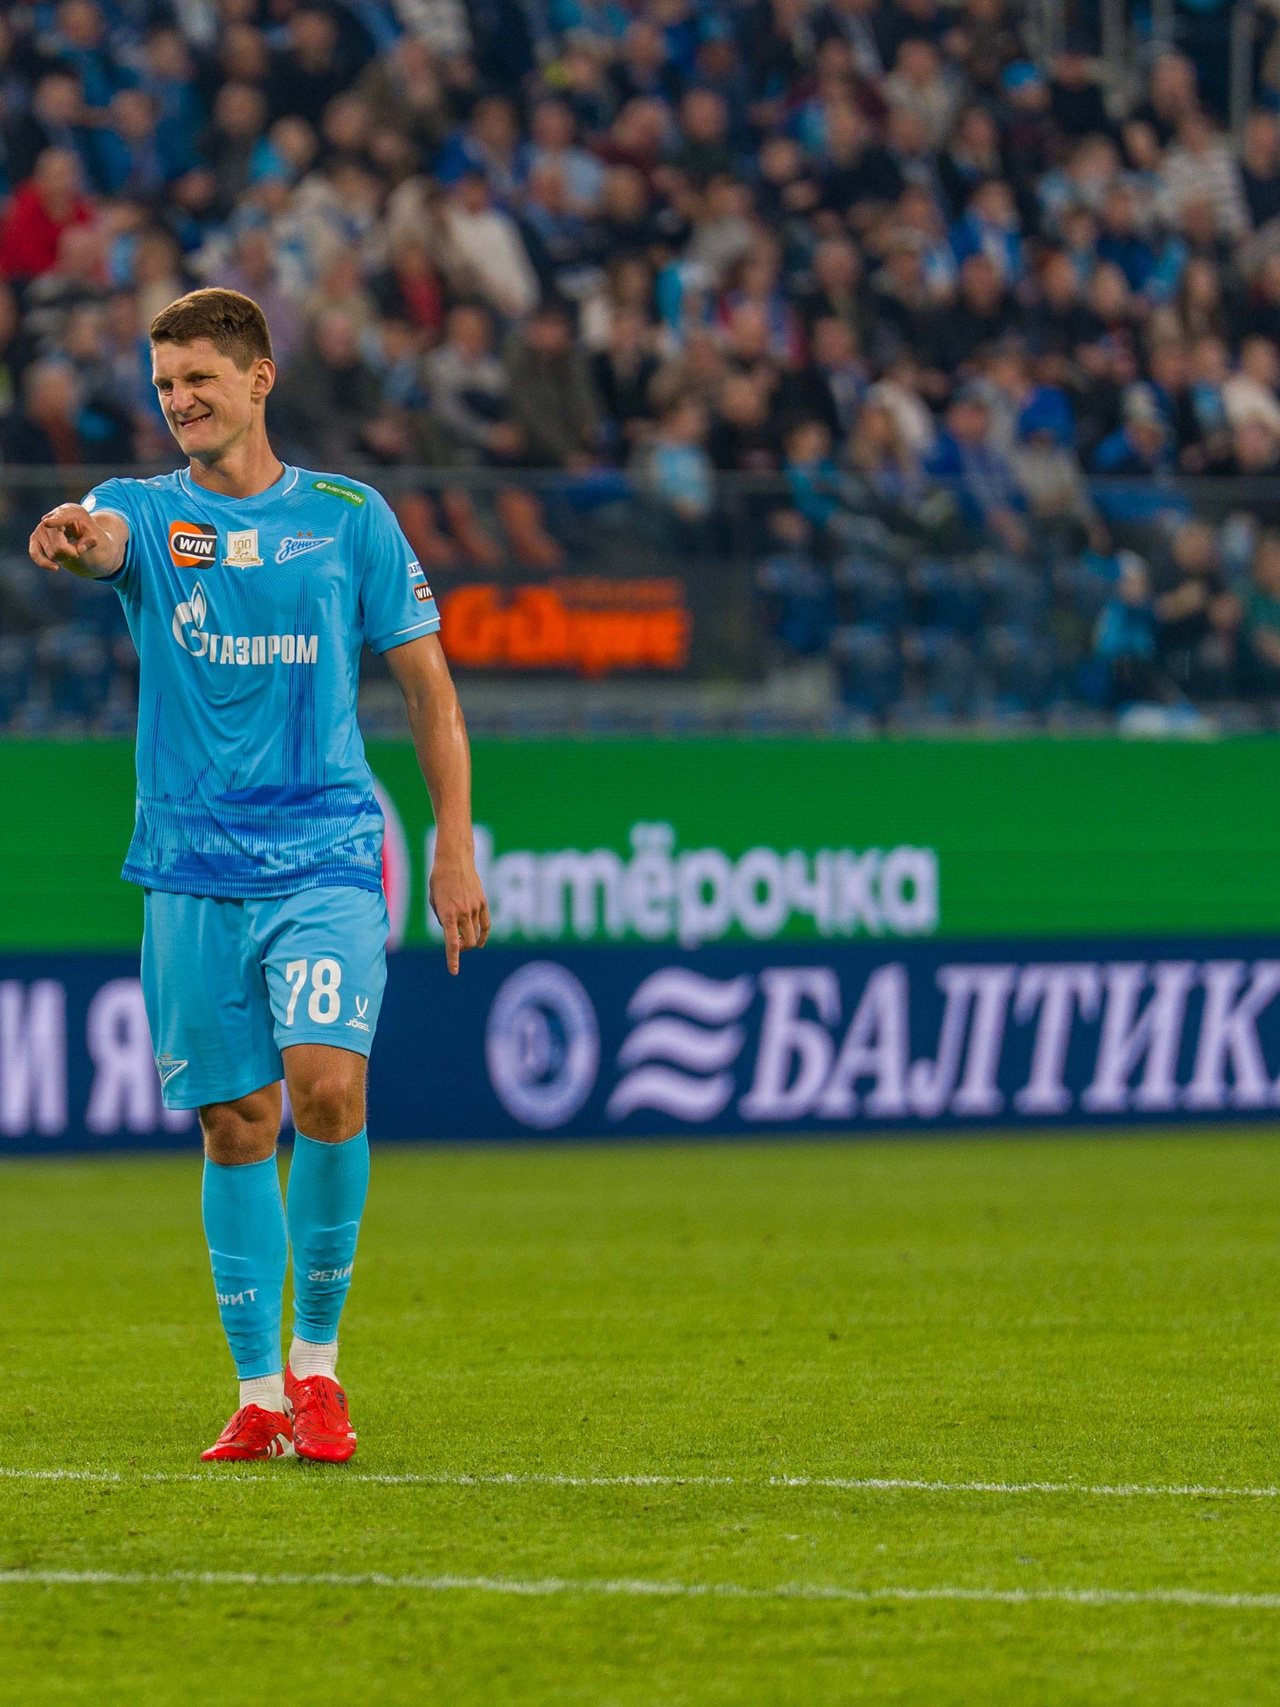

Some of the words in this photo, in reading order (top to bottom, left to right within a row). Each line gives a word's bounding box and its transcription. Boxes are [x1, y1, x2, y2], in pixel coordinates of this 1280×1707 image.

[325, 484, 363, 503] МЕГАФОН
[179, 537, 213, 554] WIN
[209, 634, 318, 665] ГАЗПРОМ
[285, 958, 341, 1025] 78
[736, 959, 1280, 1122] БАЛТИК
